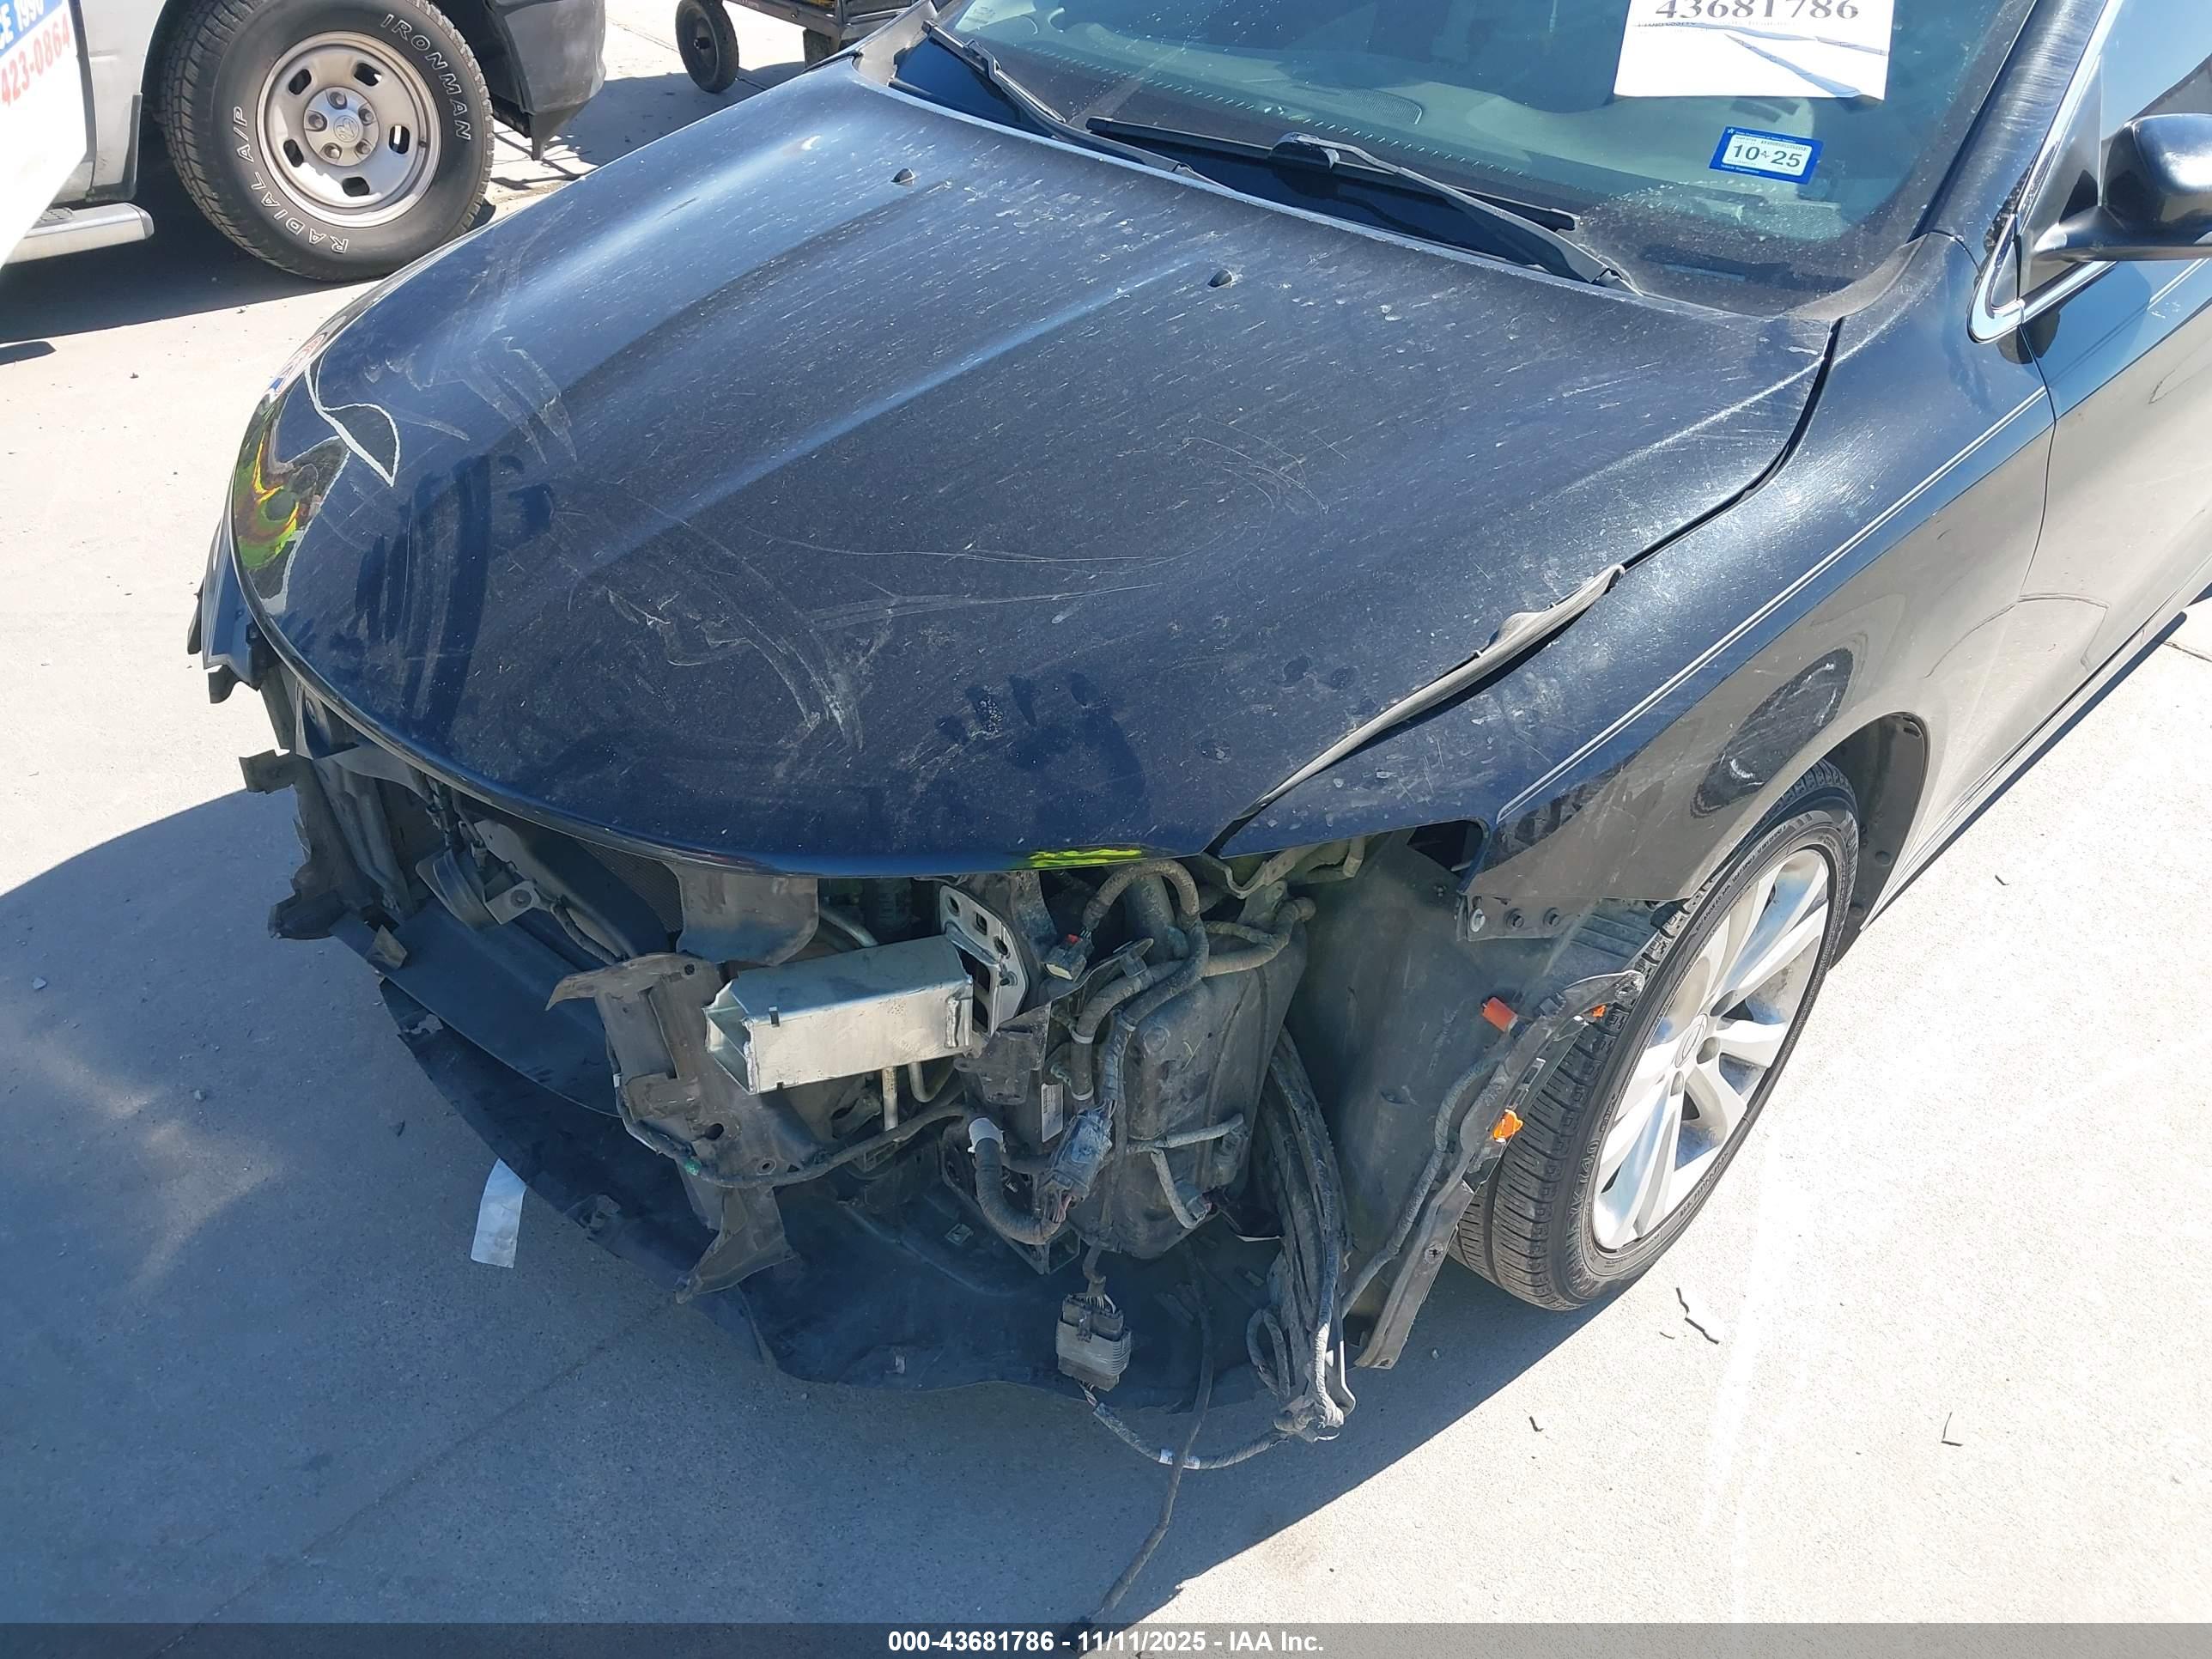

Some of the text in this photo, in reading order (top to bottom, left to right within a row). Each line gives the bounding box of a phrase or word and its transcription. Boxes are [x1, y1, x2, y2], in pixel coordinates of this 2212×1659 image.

[1, 13, 70, 107] 423-0864
[380, 14, 472, 141] IRONMAN
[233, 106, 349, 254] RADIAL A/P
[1734, 144, 1760, 161] 10
[1771, 150, 1802, 167] 25
